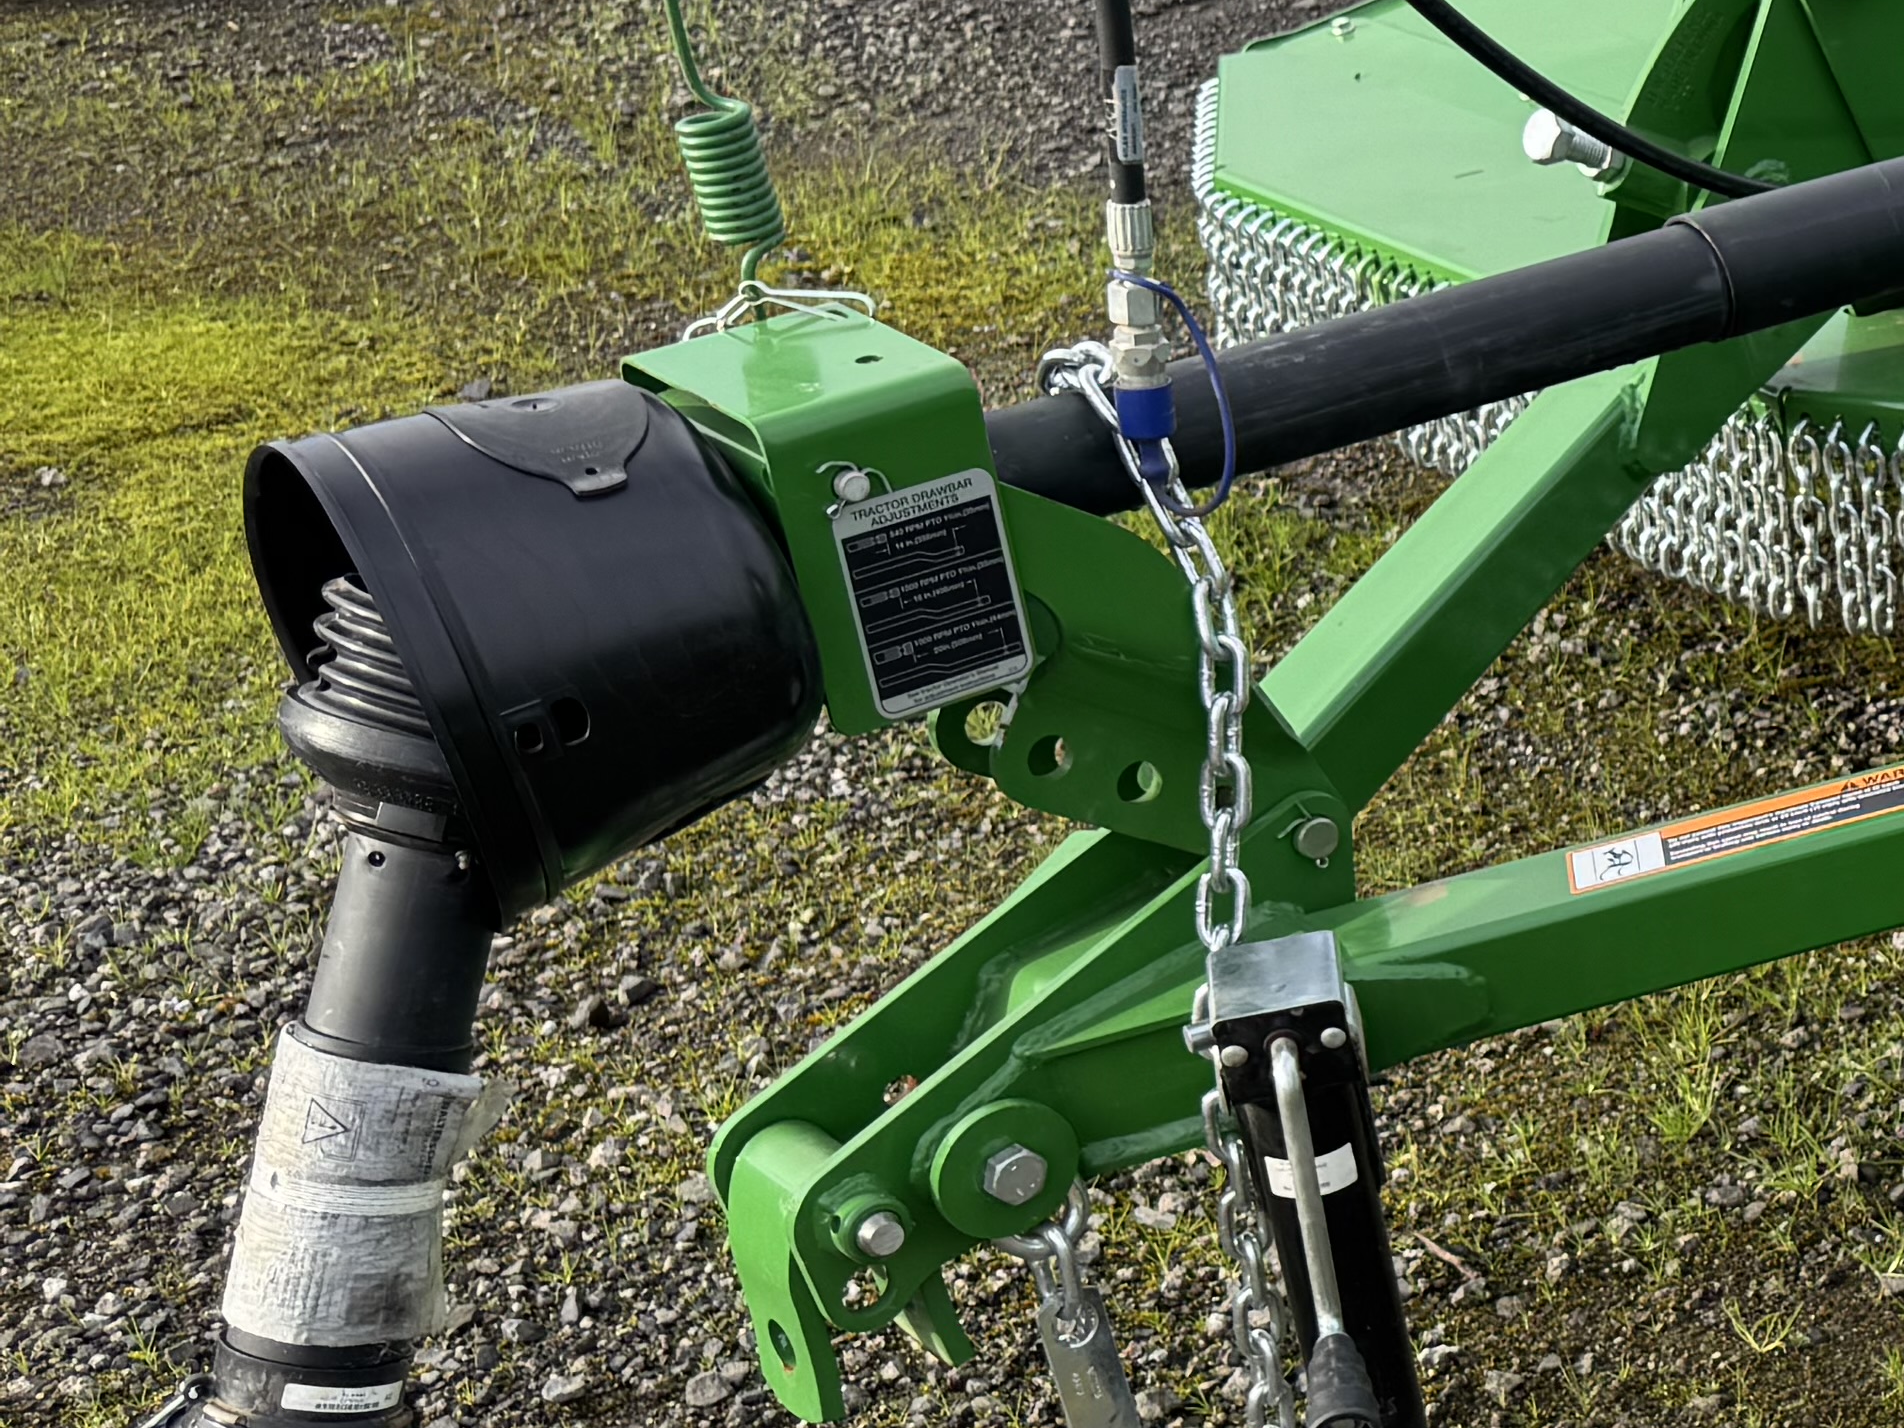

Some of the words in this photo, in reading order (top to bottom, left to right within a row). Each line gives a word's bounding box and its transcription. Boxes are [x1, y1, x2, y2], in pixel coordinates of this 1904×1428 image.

[851, 494, 909, 521] TRACTOR
[912, 478, 973, 503] DRAWBAR
[871, 494, 959, 527] ADJUSTMENTS
[925, 515, 943, 529] PTO
[940, 570, 957, 583] PTO
[953, 623, 970, 637] PTO
